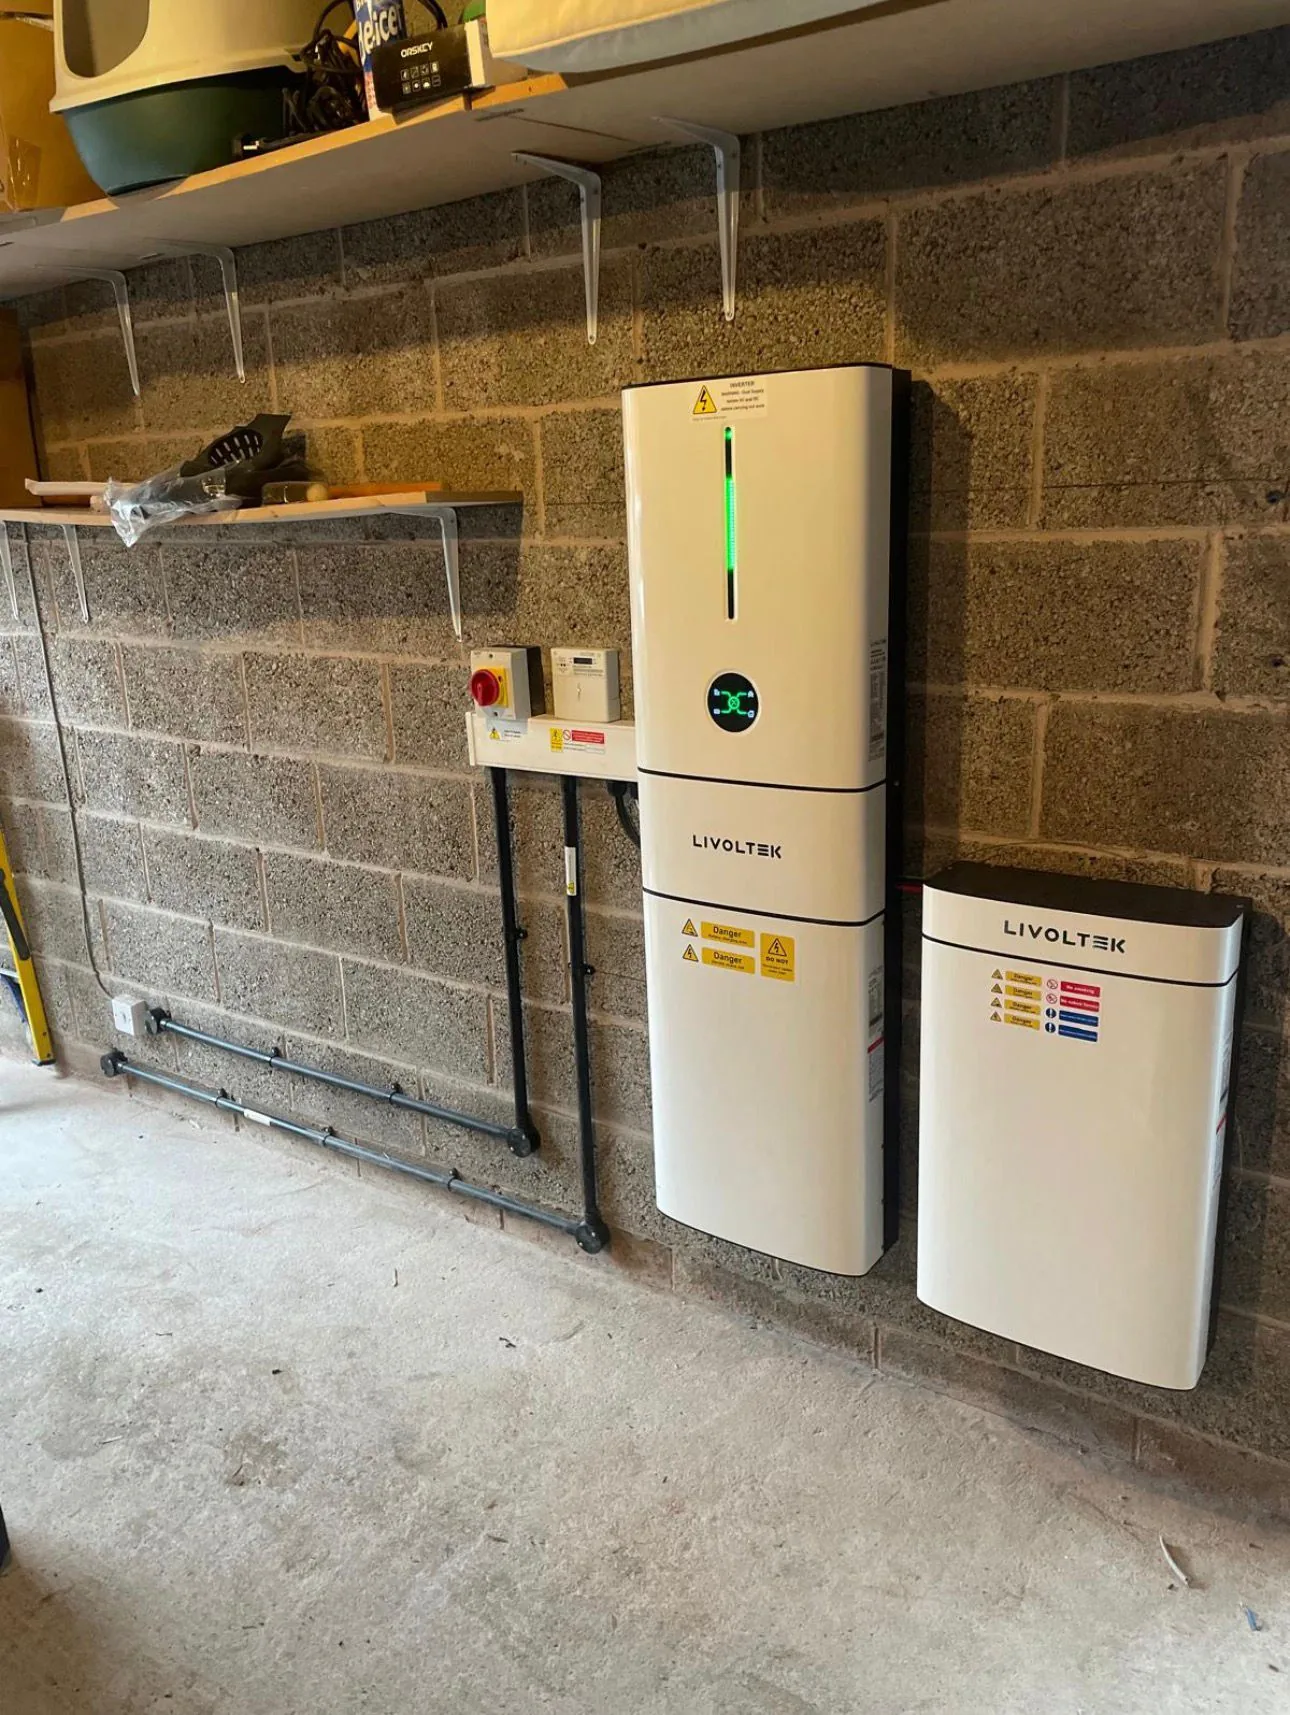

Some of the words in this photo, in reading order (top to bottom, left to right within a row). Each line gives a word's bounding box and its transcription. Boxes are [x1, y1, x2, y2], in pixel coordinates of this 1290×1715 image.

[400, 42, 434, 58] ORSKEY
[692, 834, 782, 859] LIVOLTEK
[713, 926, 742, 938] Danger
[1003, 920, 1126, 954] LIVOLTEK
[713, 951, 743, 964] Danger
